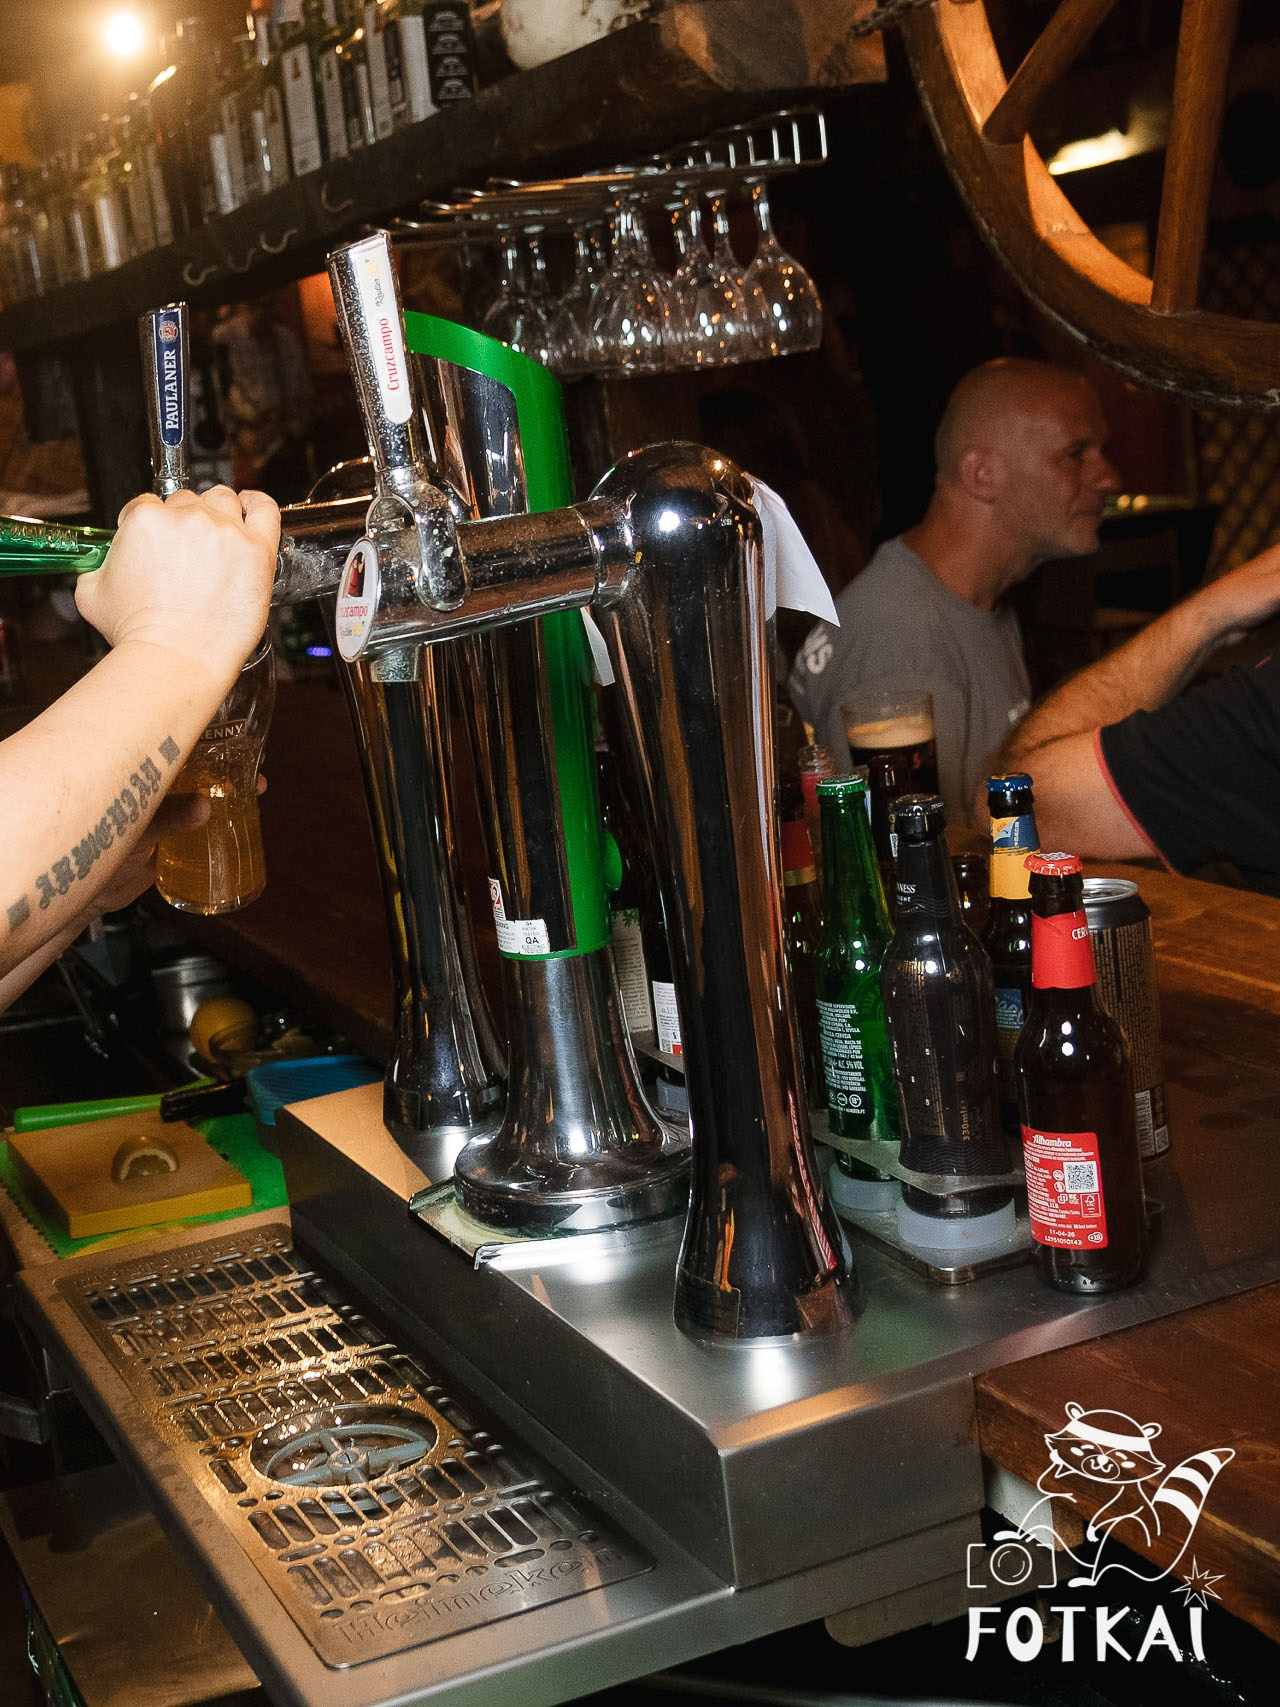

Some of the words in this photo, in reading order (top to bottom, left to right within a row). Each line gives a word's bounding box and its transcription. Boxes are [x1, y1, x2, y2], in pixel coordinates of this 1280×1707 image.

[164, 349, 179, 431] PAULANER
[375, 317, 400, 392] Cruzcampo
[525, 936, 540, 945] QA
[1032, 1134, 1072, 1148] Alhambra
[334, 1546, 623, 1644] Heineken
